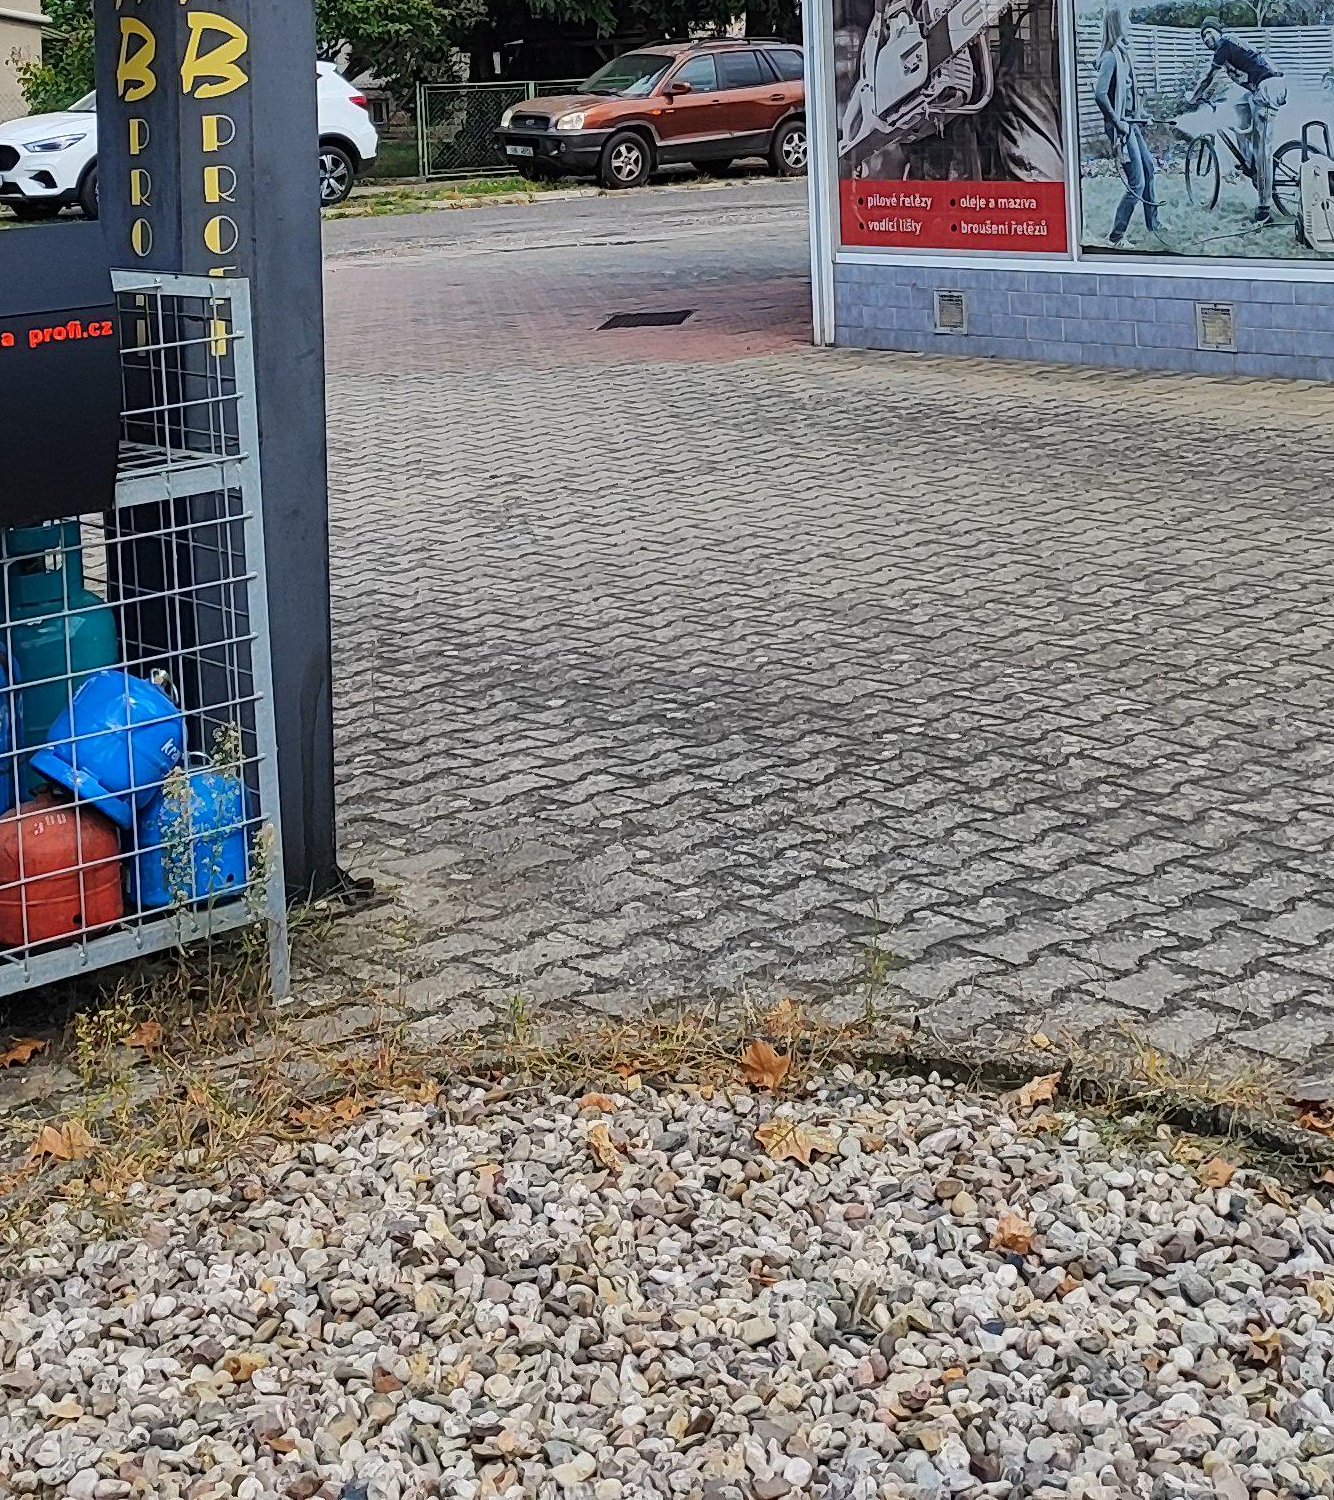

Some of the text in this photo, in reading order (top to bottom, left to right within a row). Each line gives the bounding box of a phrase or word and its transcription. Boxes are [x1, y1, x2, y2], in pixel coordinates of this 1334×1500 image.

[988, 198, 996, 208] a
[997, 197, 1037, 210] maziva
[28, 319, 114, 349] profi.cz
